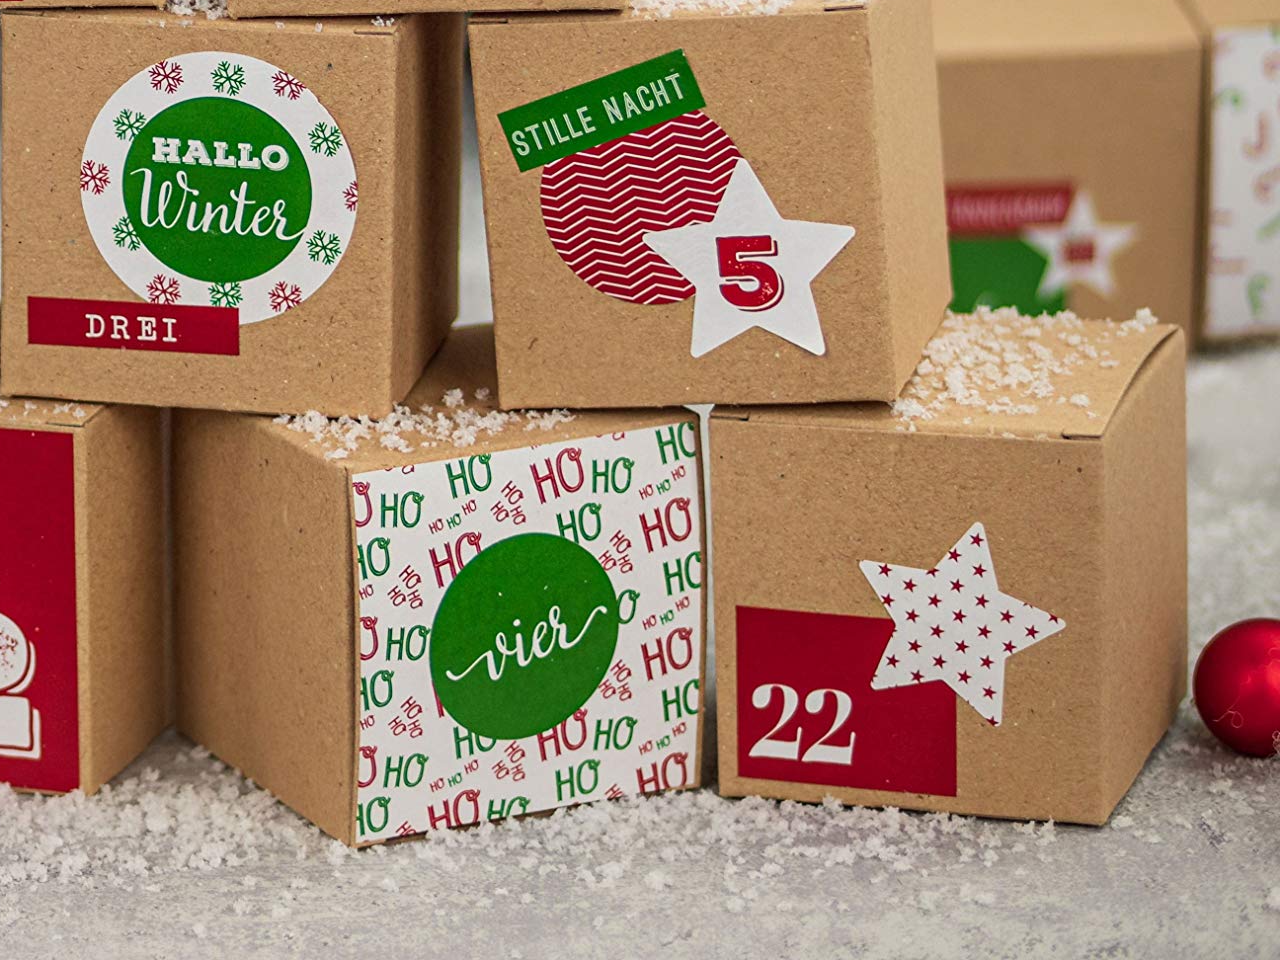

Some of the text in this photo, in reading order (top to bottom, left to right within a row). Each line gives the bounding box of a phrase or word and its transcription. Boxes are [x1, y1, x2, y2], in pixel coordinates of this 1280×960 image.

[511, 72, 685, 156] STILLE NACHT
[152, 137, 289, 171] HALLO
[130, 168, 308, 240] Winter
[716, 235, 784, 312] 5
[85, 314, 178, 342] DREI
[445, 454, 492, 498] HO
[530, 448, 584, 504] HO
[592, 456, 634, 493] HO
[381, 491, 424, 528] HO
[556, 502, 602, 544] HO
[639, 497, 692, 553] HO
[386, 624, 430, 661] HO
[446, 604, 607, 681] vier
[641, 627, 693, 682] HO
[536, 708, 588, 762] HO
[593, 716, 638, 750] HO
[748, 684, 856, 766] 22
[383, 753, 428, 788] HO
[556, 759, 600, 802] HO
[636, 752, 688, 793] HO
[428, 789, 480, 829] HO
